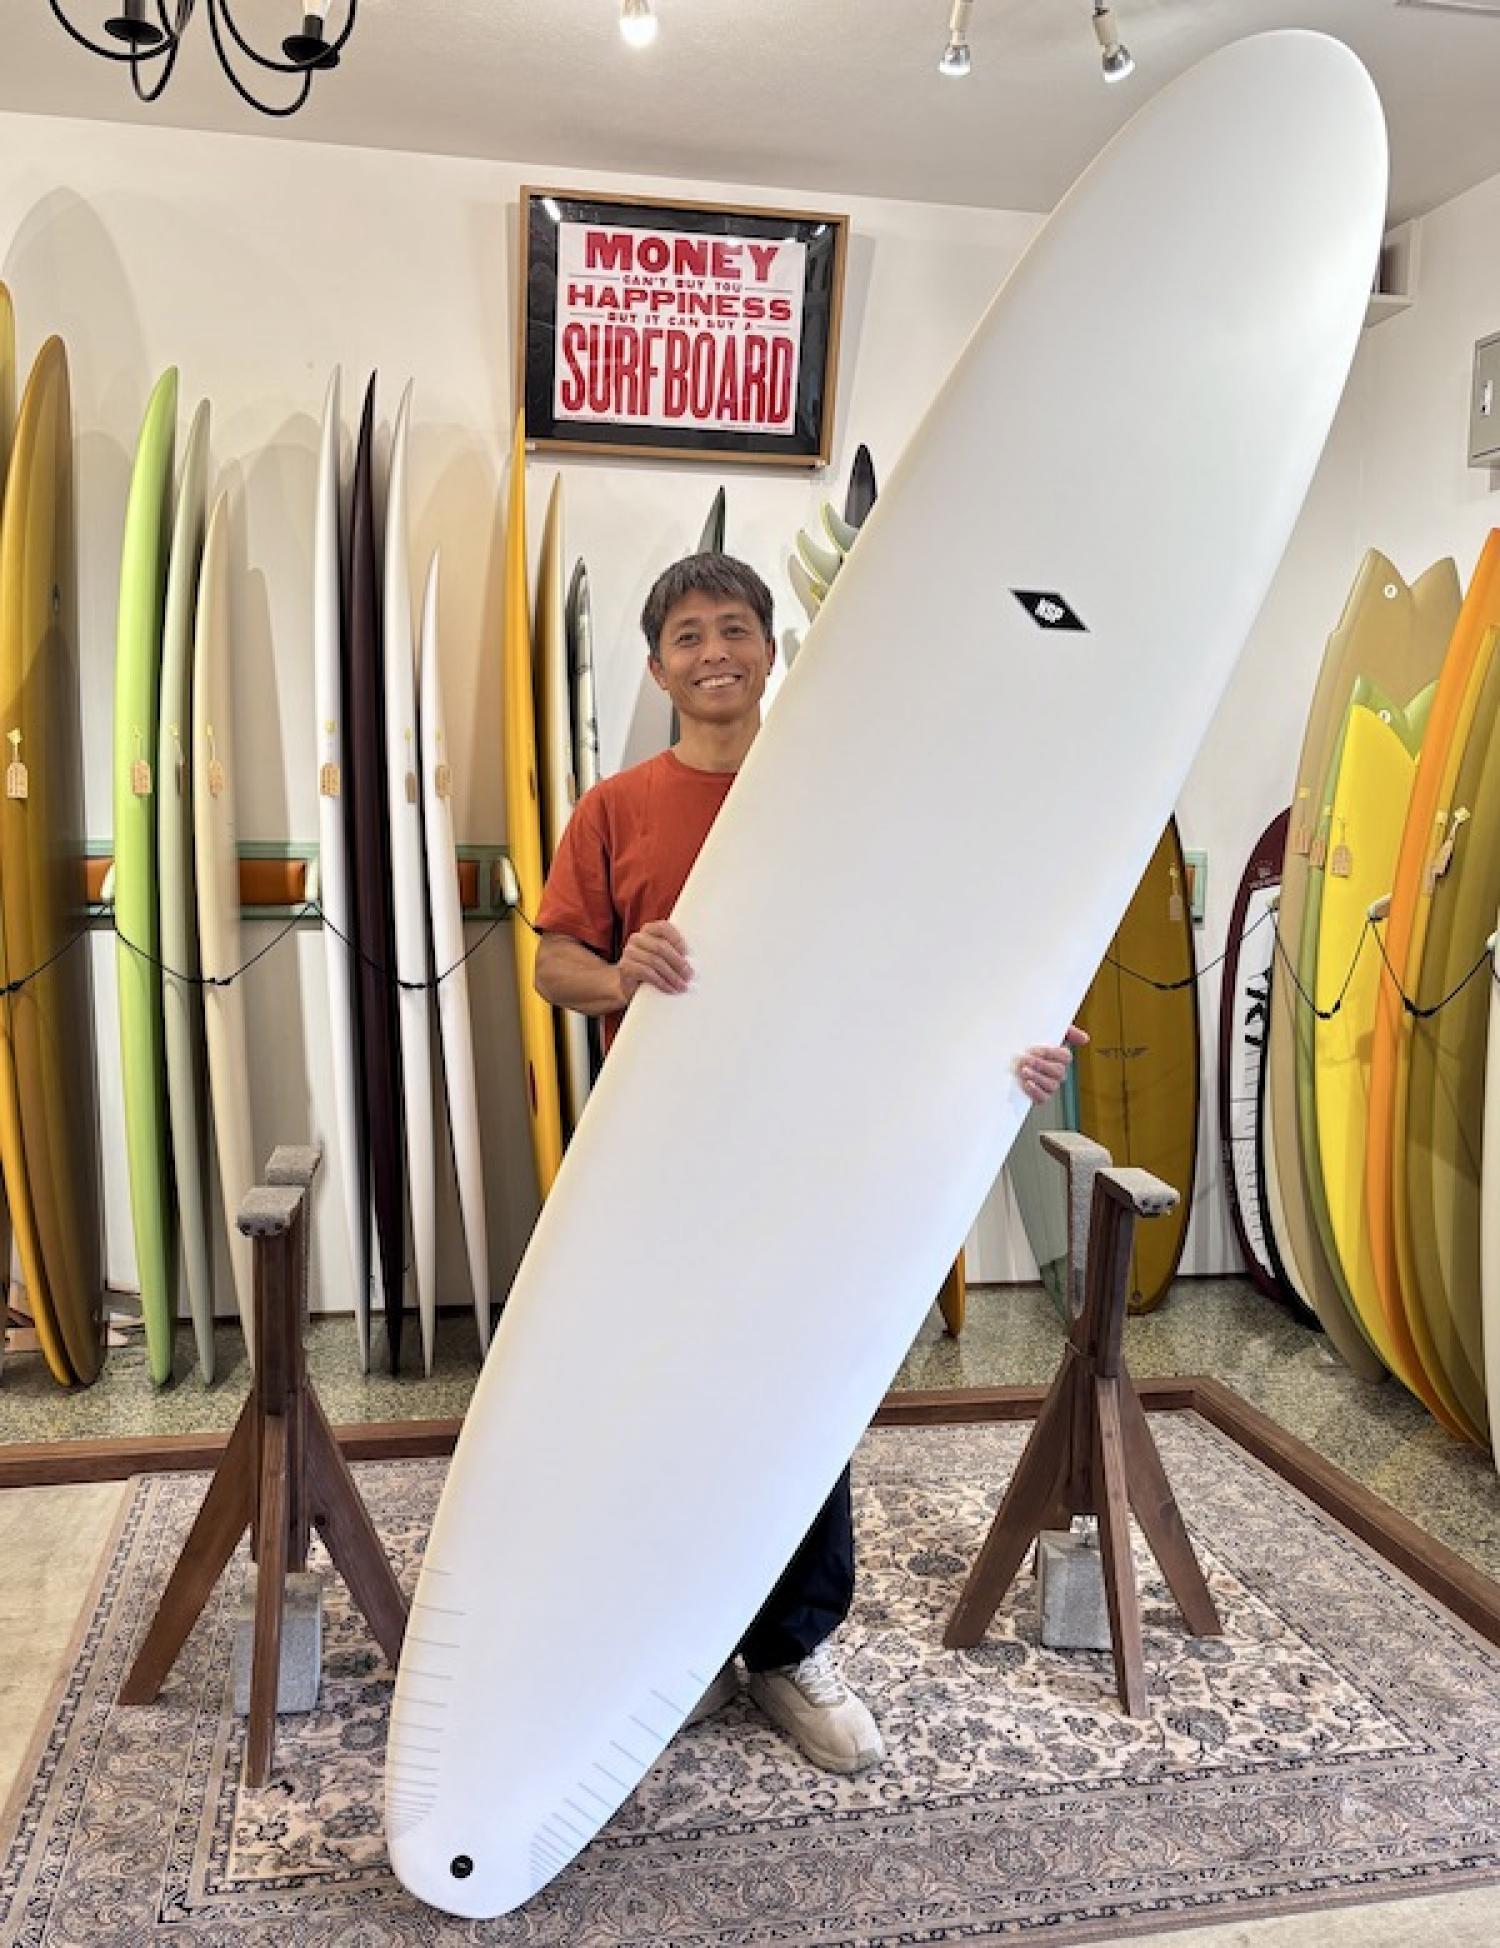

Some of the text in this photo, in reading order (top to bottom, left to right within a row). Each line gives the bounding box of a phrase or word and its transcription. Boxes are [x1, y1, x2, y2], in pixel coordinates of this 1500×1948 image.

[586, 232, 778, 280] MONEY
[623, 275, 743, 293] CAN'T BUY YOU
[568, 285, 791, 320] HAPPINESS
[607, 312, 638, 323] BUT
[645, 314, 661, 326] IT
[668, 317, 699, 328] CAN
[707, 320, 735, 330] BUY
[562, 323, 793, 423] SURFBOARD
